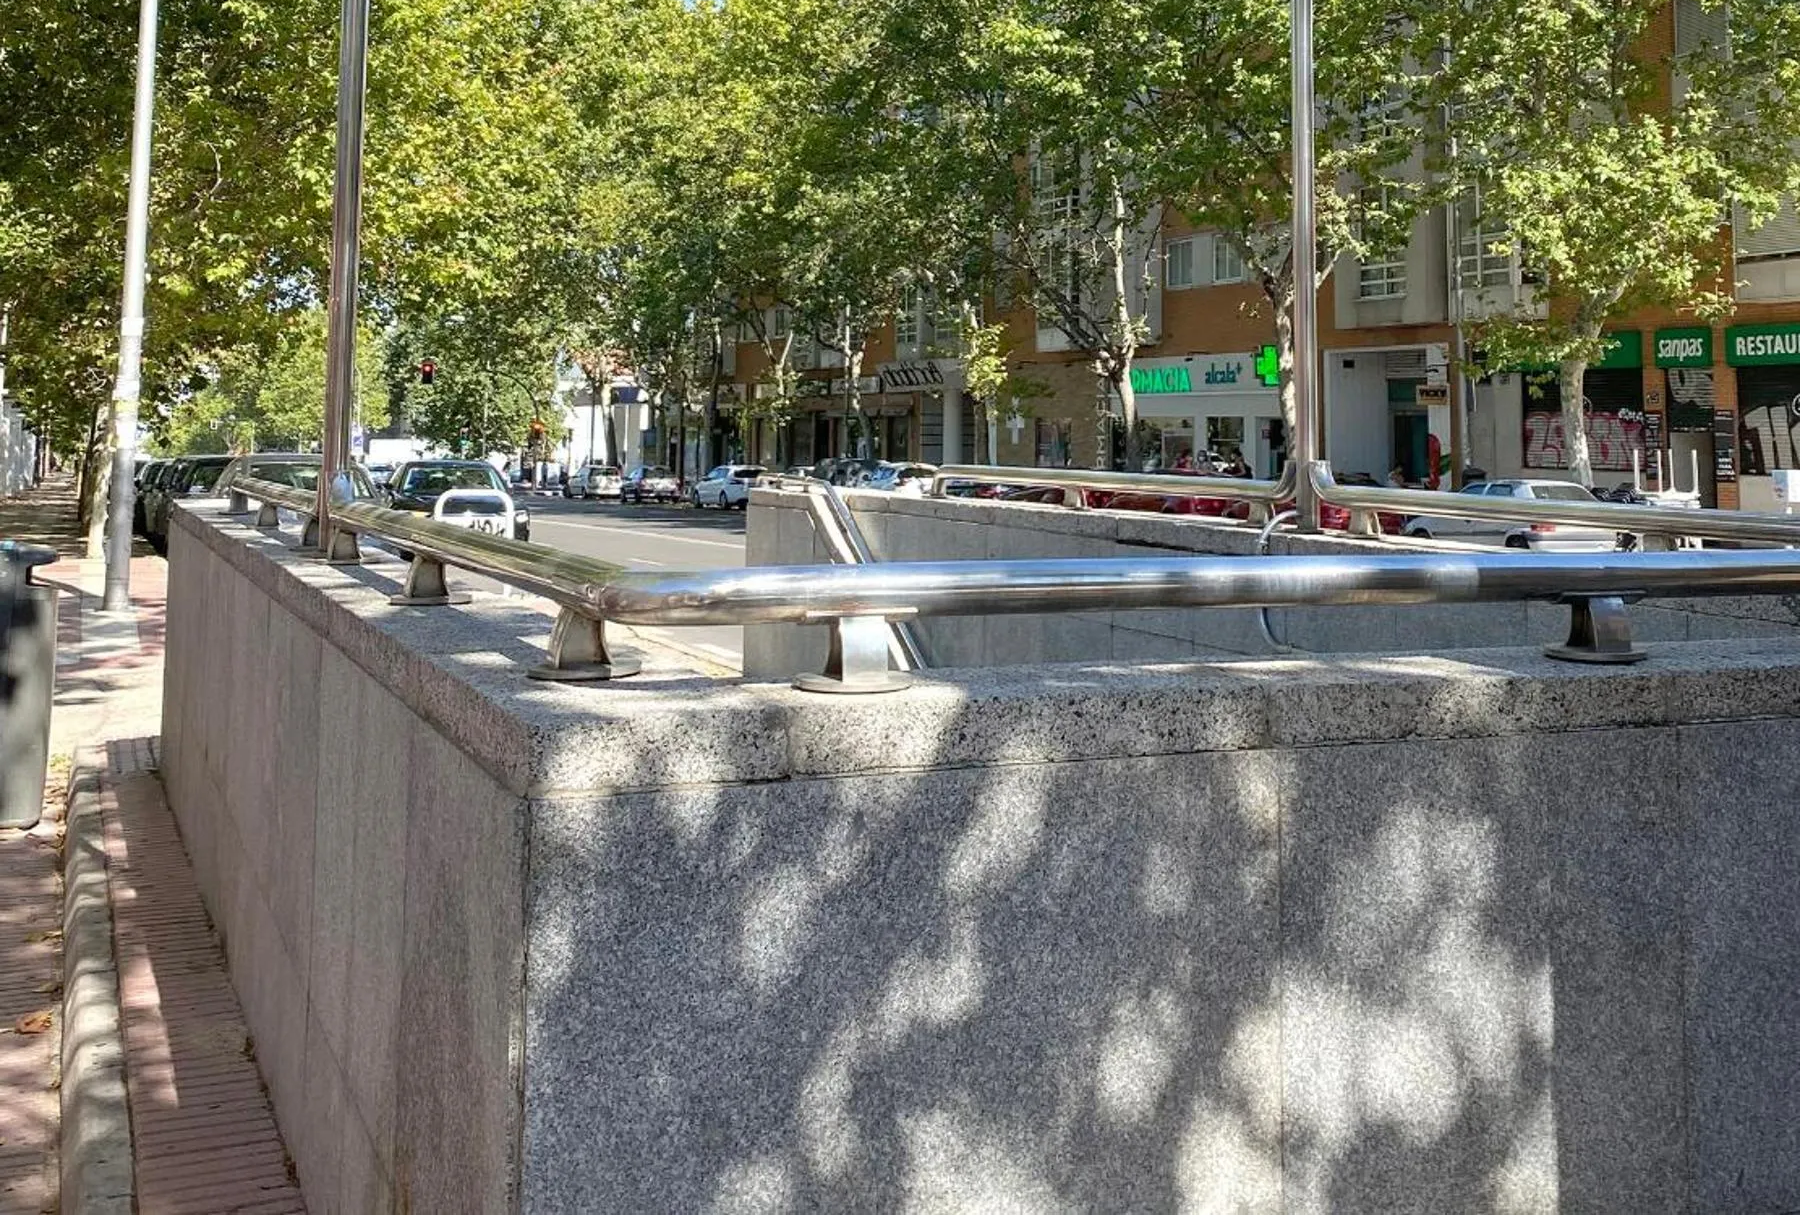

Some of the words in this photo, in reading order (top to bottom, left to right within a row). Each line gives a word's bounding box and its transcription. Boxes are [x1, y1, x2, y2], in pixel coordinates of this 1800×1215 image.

[1658, 337, 1703, 362] sanpas
[1735, 333, 1800, 356] RESTAU
[1130, 367, 1192, 393] RMACIA
